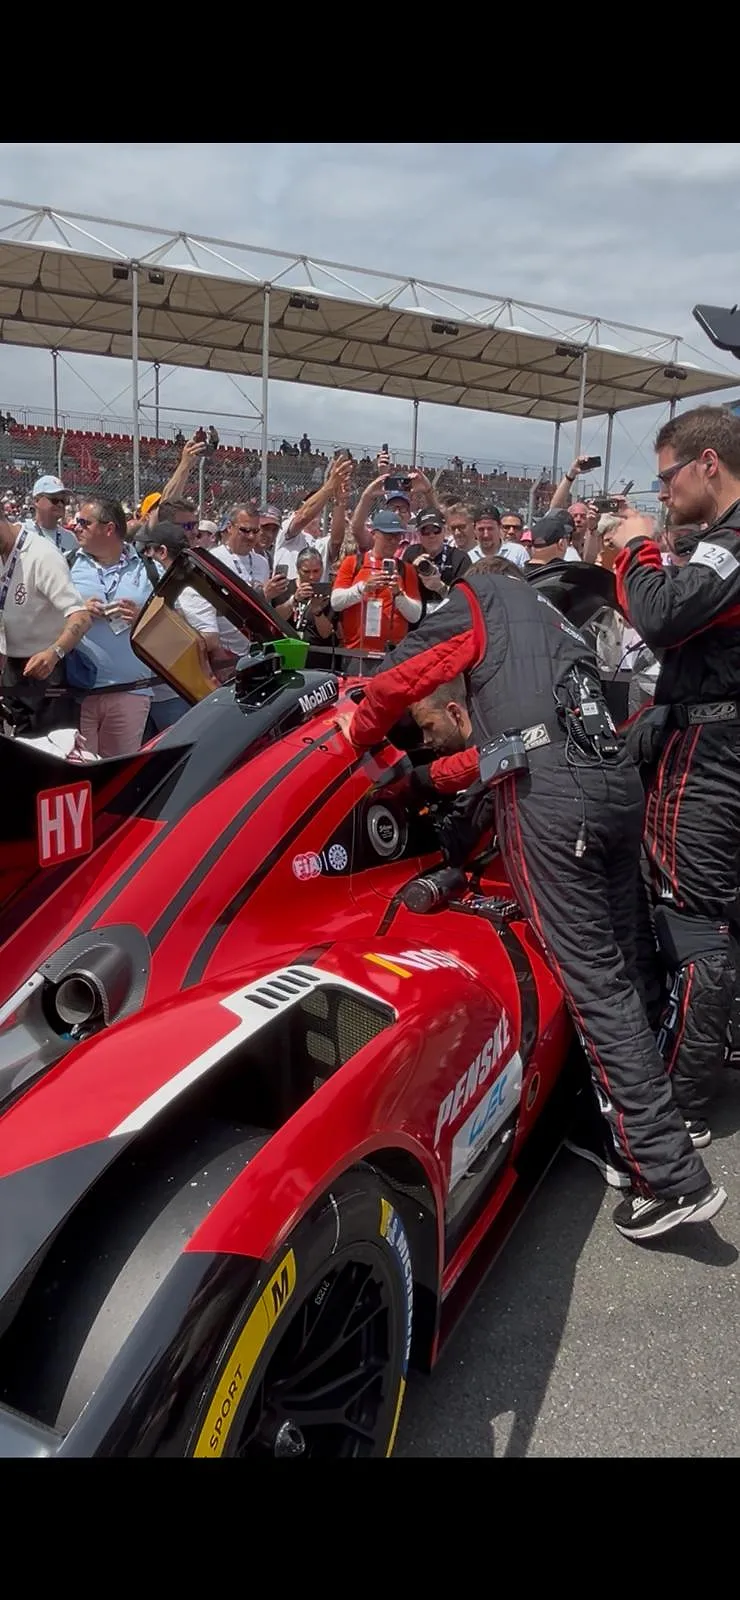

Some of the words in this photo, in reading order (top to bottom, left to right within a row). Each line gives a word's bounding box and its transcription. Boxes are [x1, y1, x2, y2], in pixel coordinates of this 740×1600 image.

[298, 685, 328, 713] Mobil
[40, 788, 89, 860] HY
[433, 1007, 511, 1150] PENSKE
[209, 1363, 244, 1450] SPORT
[271, 1266, 290, 1316] M
